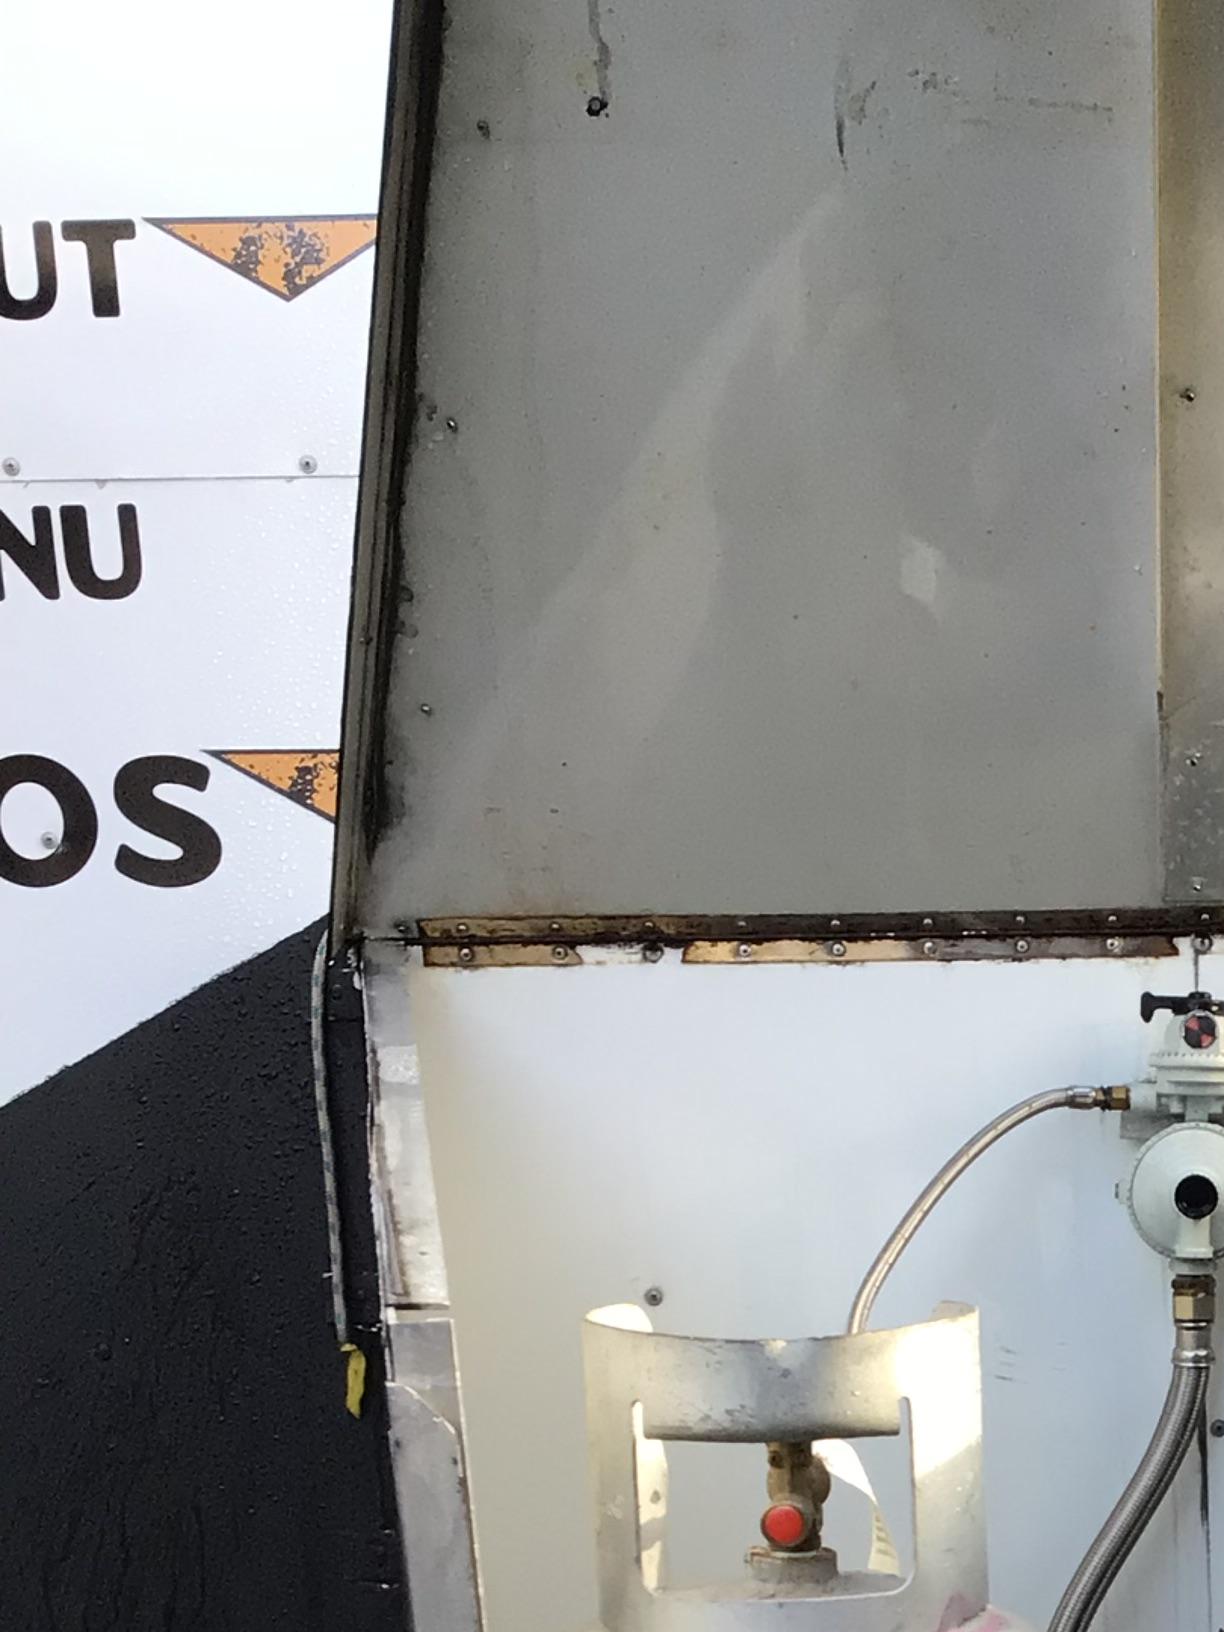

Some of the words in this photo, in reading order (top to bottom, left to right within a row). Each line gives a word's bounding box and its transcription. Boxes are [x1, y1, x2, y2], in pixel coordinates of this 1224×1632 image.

[0, 219, 136, 321] UT
[0, 503, 142, 601] NU
[0, 753, 223, 888] OS
